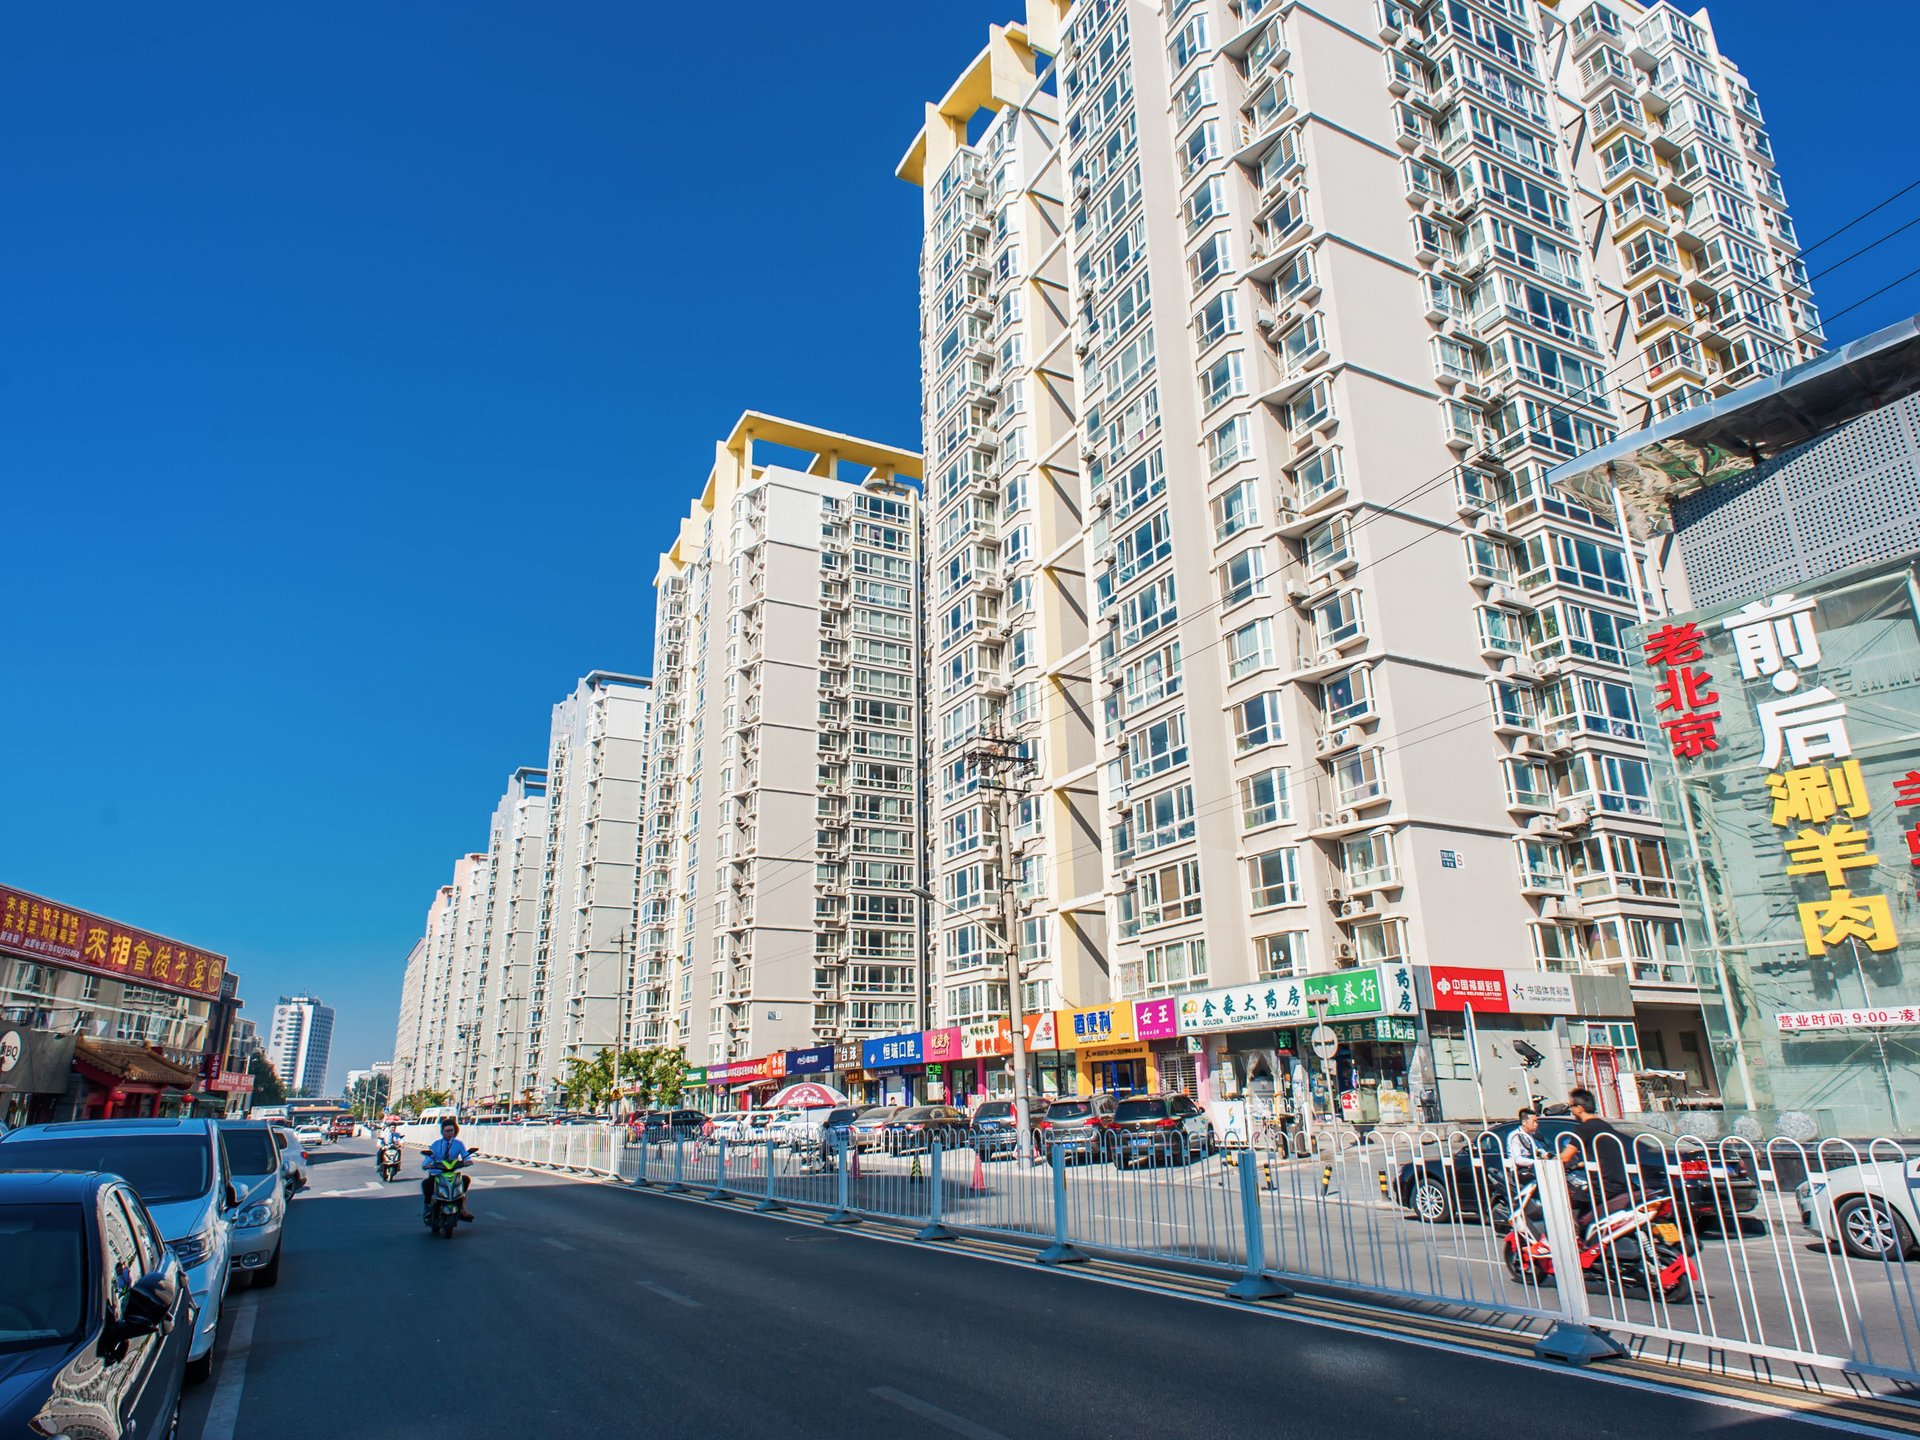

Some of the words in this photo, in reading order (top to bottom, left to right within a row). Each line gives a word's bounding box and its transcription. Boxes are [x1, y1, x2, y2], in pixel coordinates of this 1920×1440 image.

[1643, 622, 1721, 758] 老北京
[1202, 985, 1300, 1018] 金象大药房
[1395, 968, 1412, 1012] 药房
[1074, 1010, 1111, 1035] 酒便利
[1140, 1004, 1169, 1025] 女王
[1203, 1019, 1224, 1027] GOLDEN
[1230, 1014, 1259, 1023] ELEPHANT
[1267, 1009, 1300, 1018] PHARMACY
[1778, 1008, 1920, 1028] 营业时间:9:00-凌
